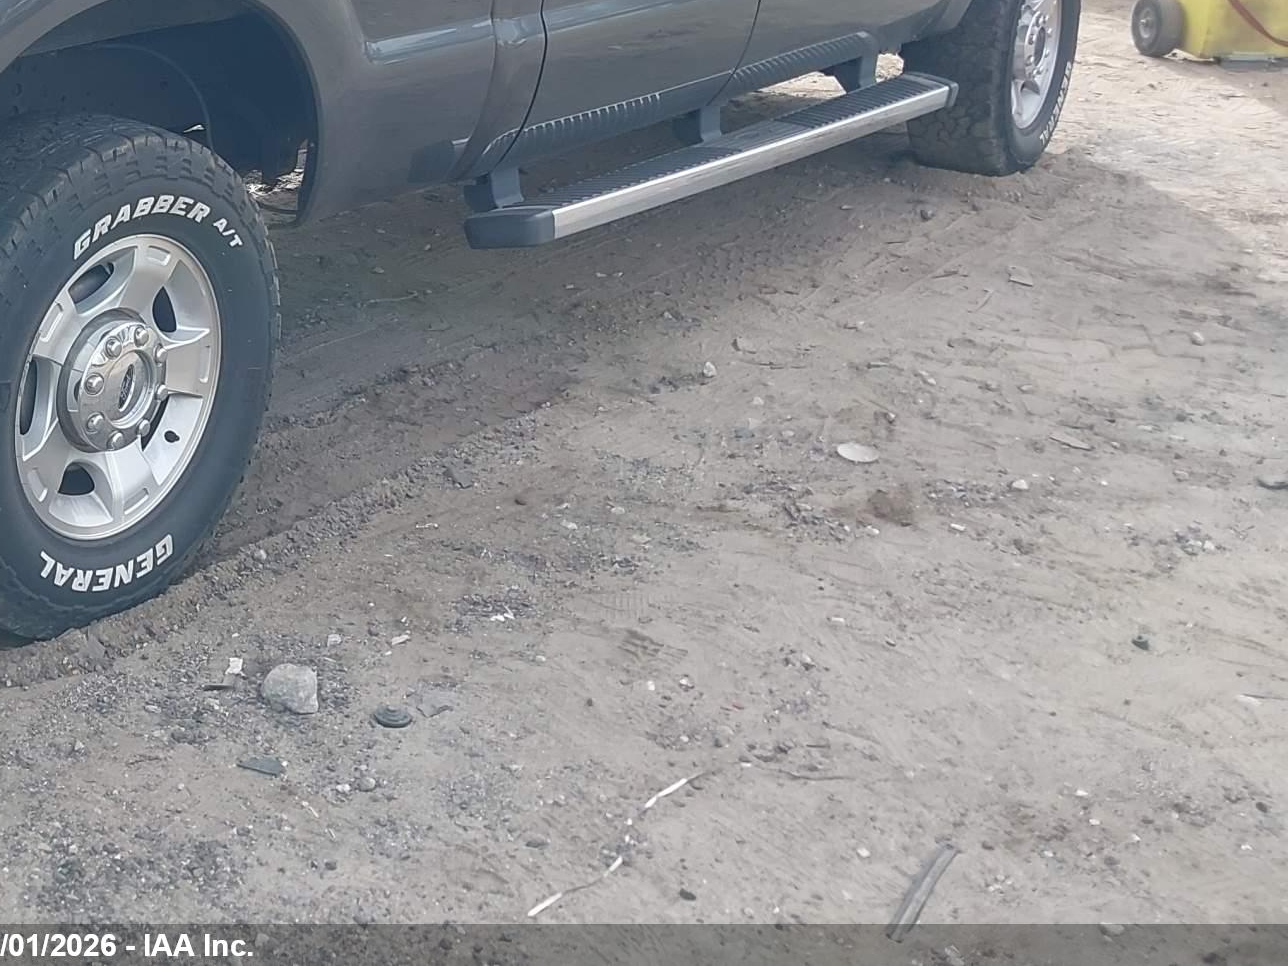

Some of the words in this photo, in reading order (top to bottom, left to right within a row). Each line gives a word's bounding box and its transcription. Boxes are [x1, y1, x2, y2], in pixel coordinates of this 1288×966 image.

[73, 195, 210, 260] GRABBER
[213, 218, 243, 248] A/T
[40, 534, 173, 592] GENERAL
